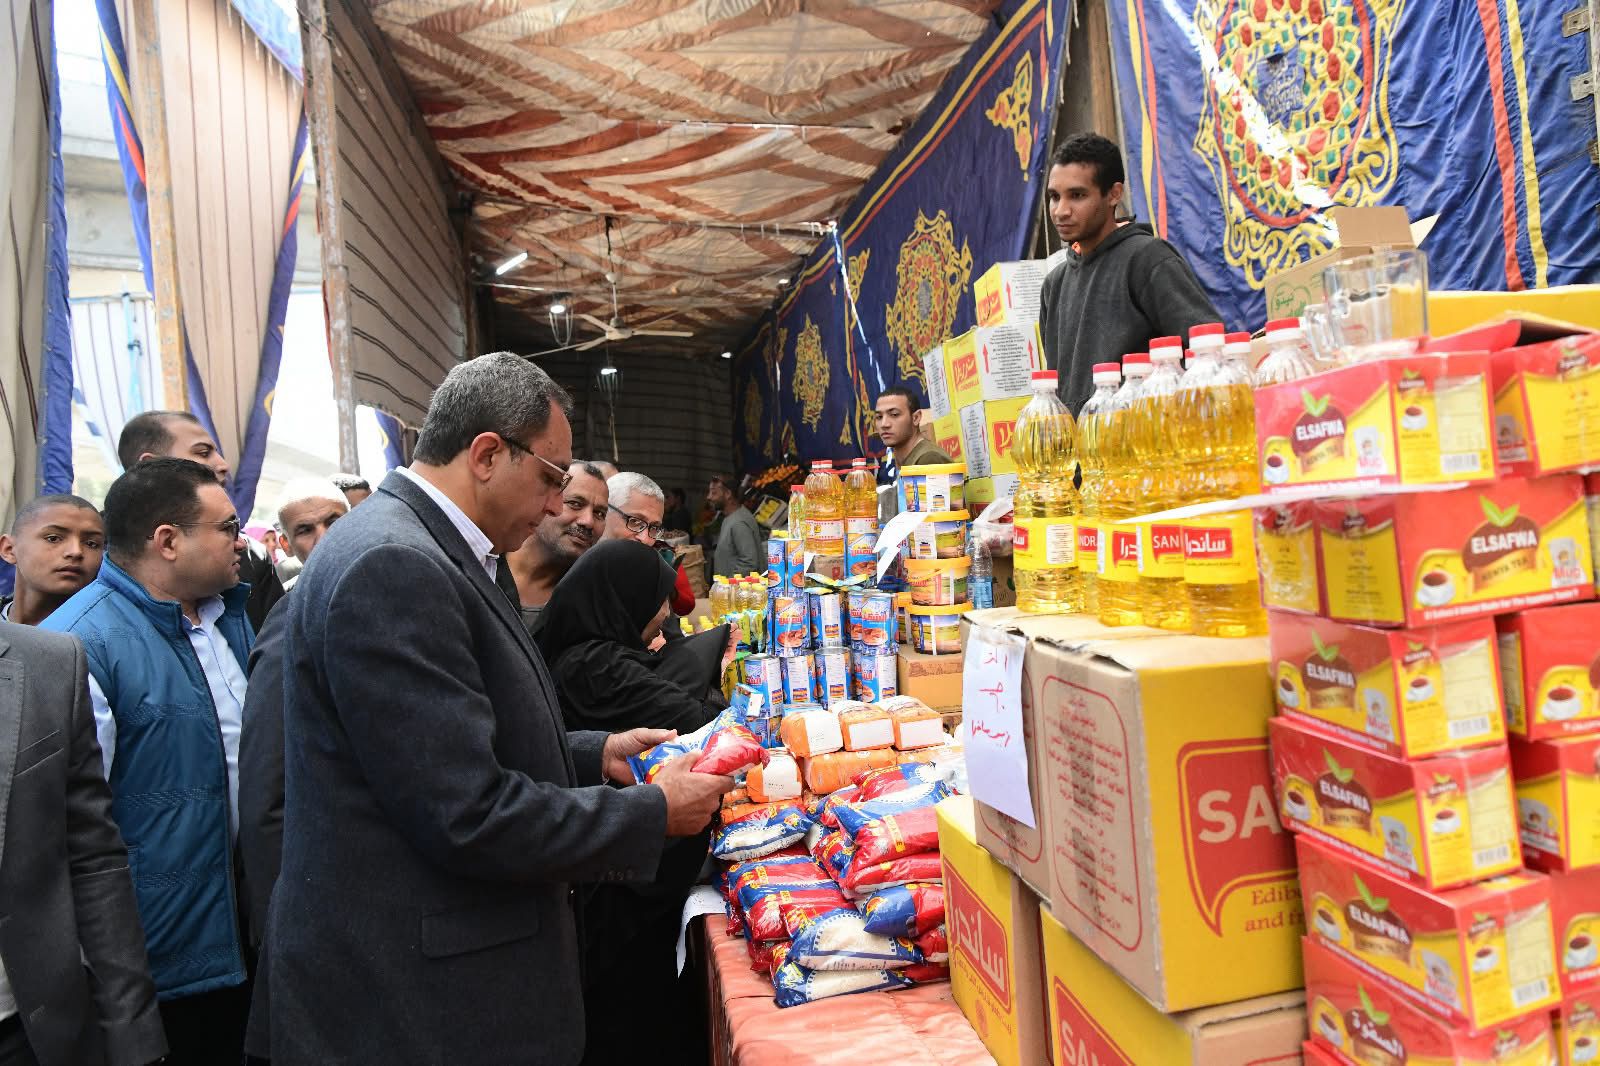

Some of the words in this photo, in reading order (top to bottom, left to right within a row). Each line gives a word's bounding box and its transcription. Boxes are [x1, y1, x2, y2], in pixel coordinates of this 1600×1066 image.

[1295, 418, 1345, 441] ELSAFWA
[1184, 531, 1227, 557] ساندرا
[1471, 529, 1538, 555] ELSAFWA
[1305, 662, 1356, 689] ELSAFWA
[1319, 779, 1372, 814] ELSAFWA
[1197, 784, 1283, 844] SA
[947, 875, 1005, 993] ساندرا
[1245, 911, 1285, 932] and
[1348, 903, 1411, 946] ELSAFWA
[1350, 1009, 1404, 1059] الصفوة
